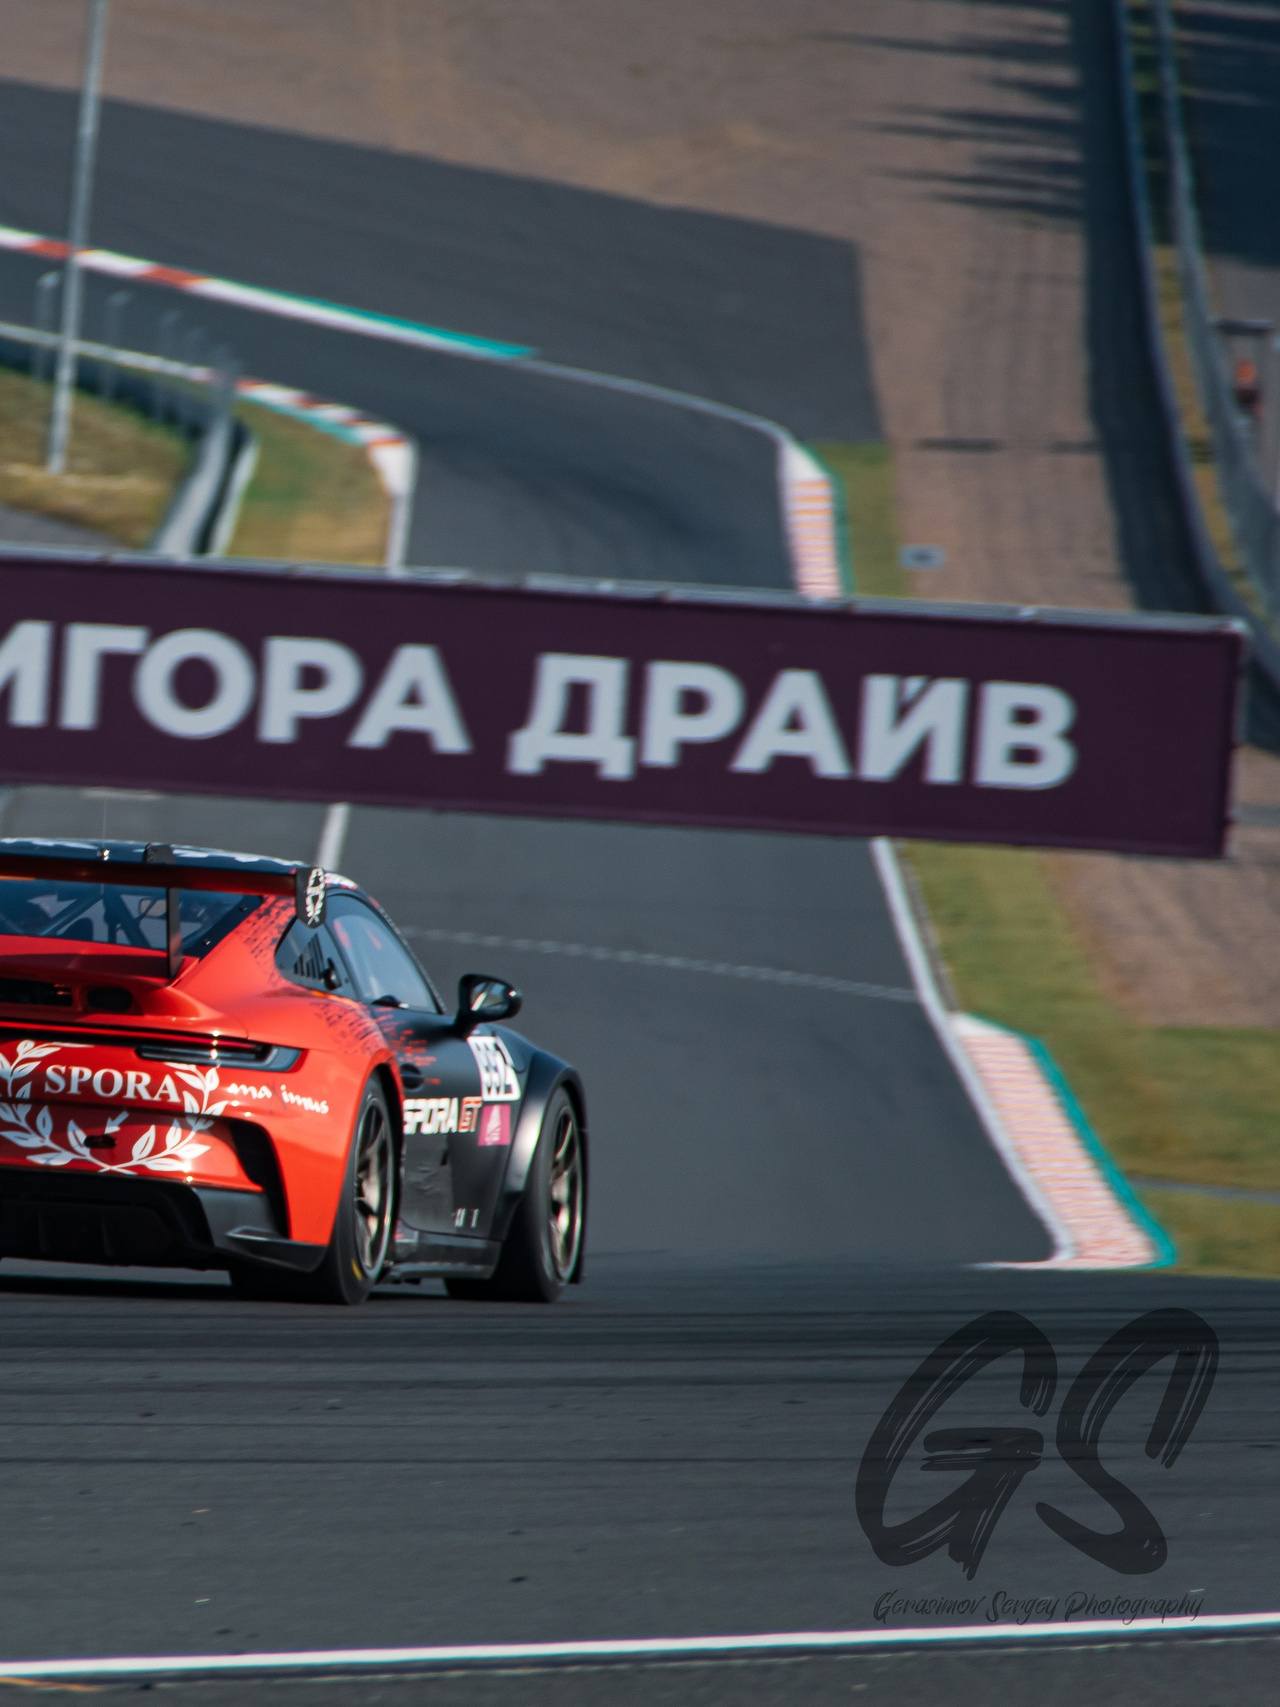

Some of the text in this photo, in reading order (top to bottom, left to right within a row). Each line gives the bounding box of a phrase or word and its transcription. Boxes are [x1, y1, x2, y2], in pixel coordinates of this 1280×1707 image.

[510, 654, 1071, 789] ДРАЙВ
[44, 1064, 182, 1104] SPORA
[402, 1098, 458, 1135] SPORA
